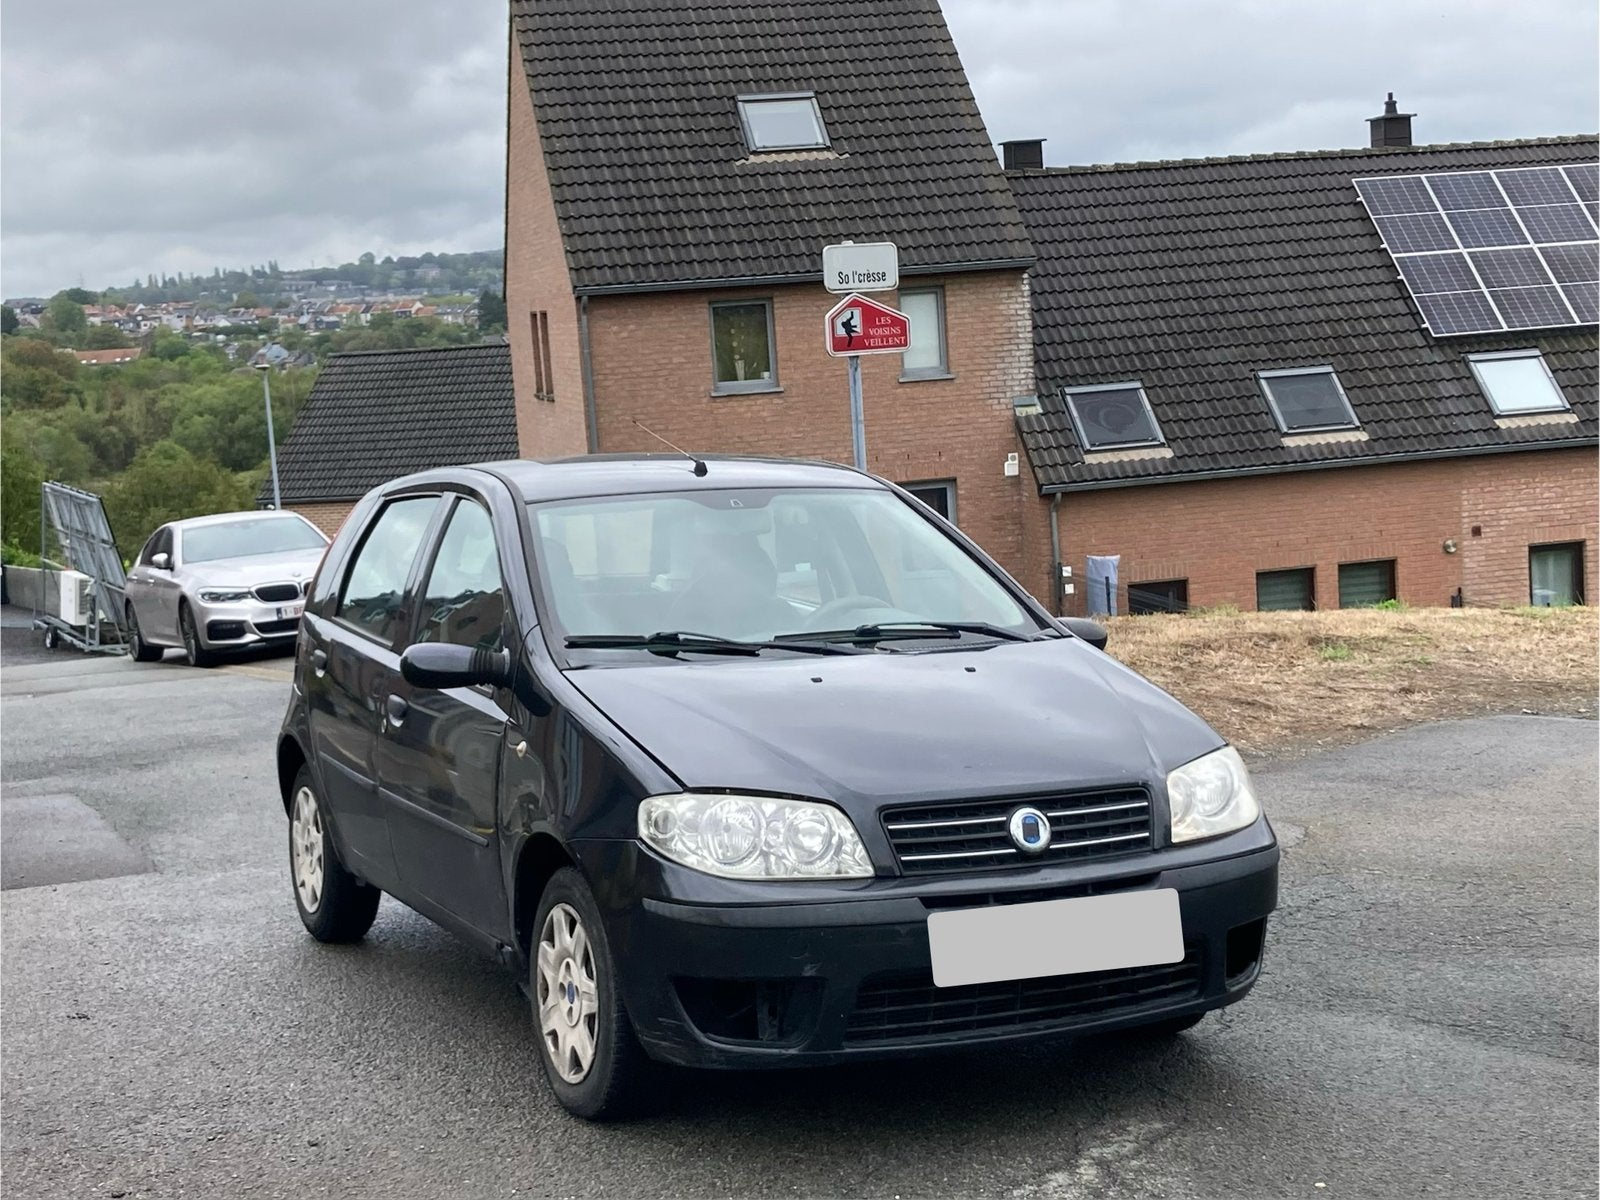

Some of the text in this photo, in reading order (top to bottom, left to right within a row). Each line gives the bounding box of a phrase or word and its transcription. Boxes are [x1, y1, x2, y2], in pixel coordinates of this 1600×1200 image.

[838, 270, 886, 284] So l'crèsse
[875, 316, 891, 325] LES
[869, 326, 901, 336] VOISINS
[864, 336, 905, 346] VEILLENT
